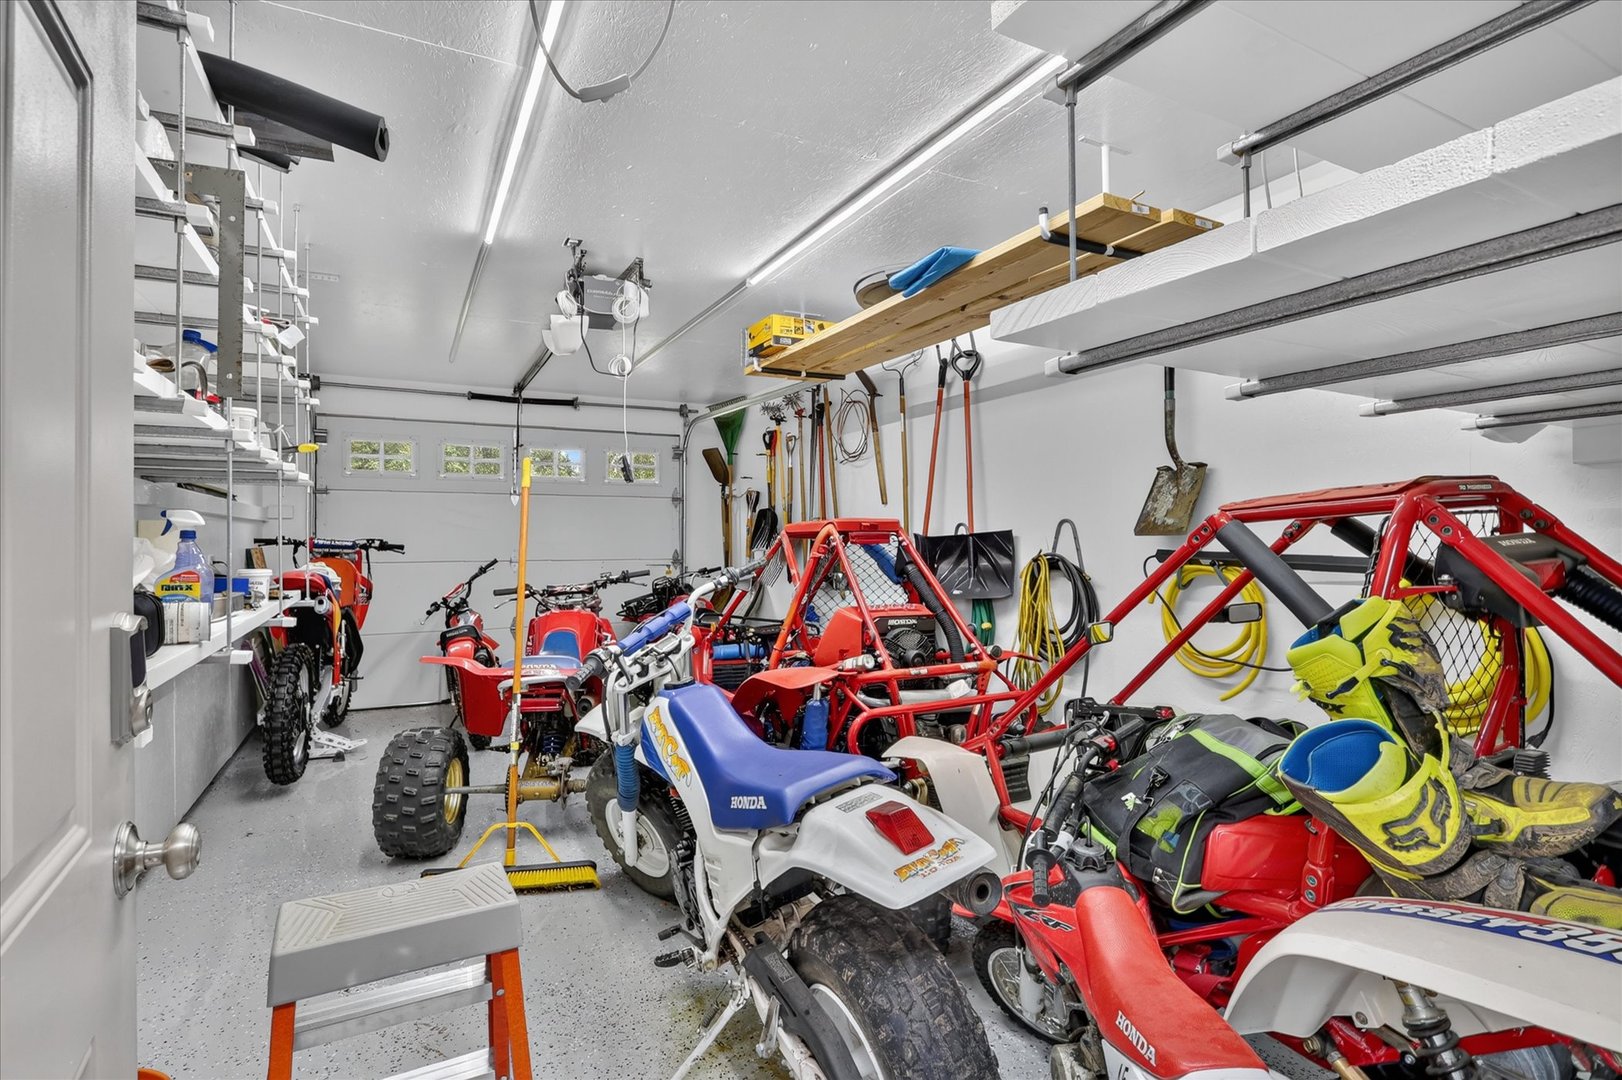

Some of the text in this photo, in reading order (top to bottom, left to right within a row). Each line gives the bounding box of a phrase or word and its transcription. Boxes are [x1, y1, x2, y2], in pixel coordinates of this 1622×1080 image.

[731, 796, 768, 810] HONDA
[1518, 922, 1622, 962] 35
[1115, 1009, 1157, 1067] HONDA
